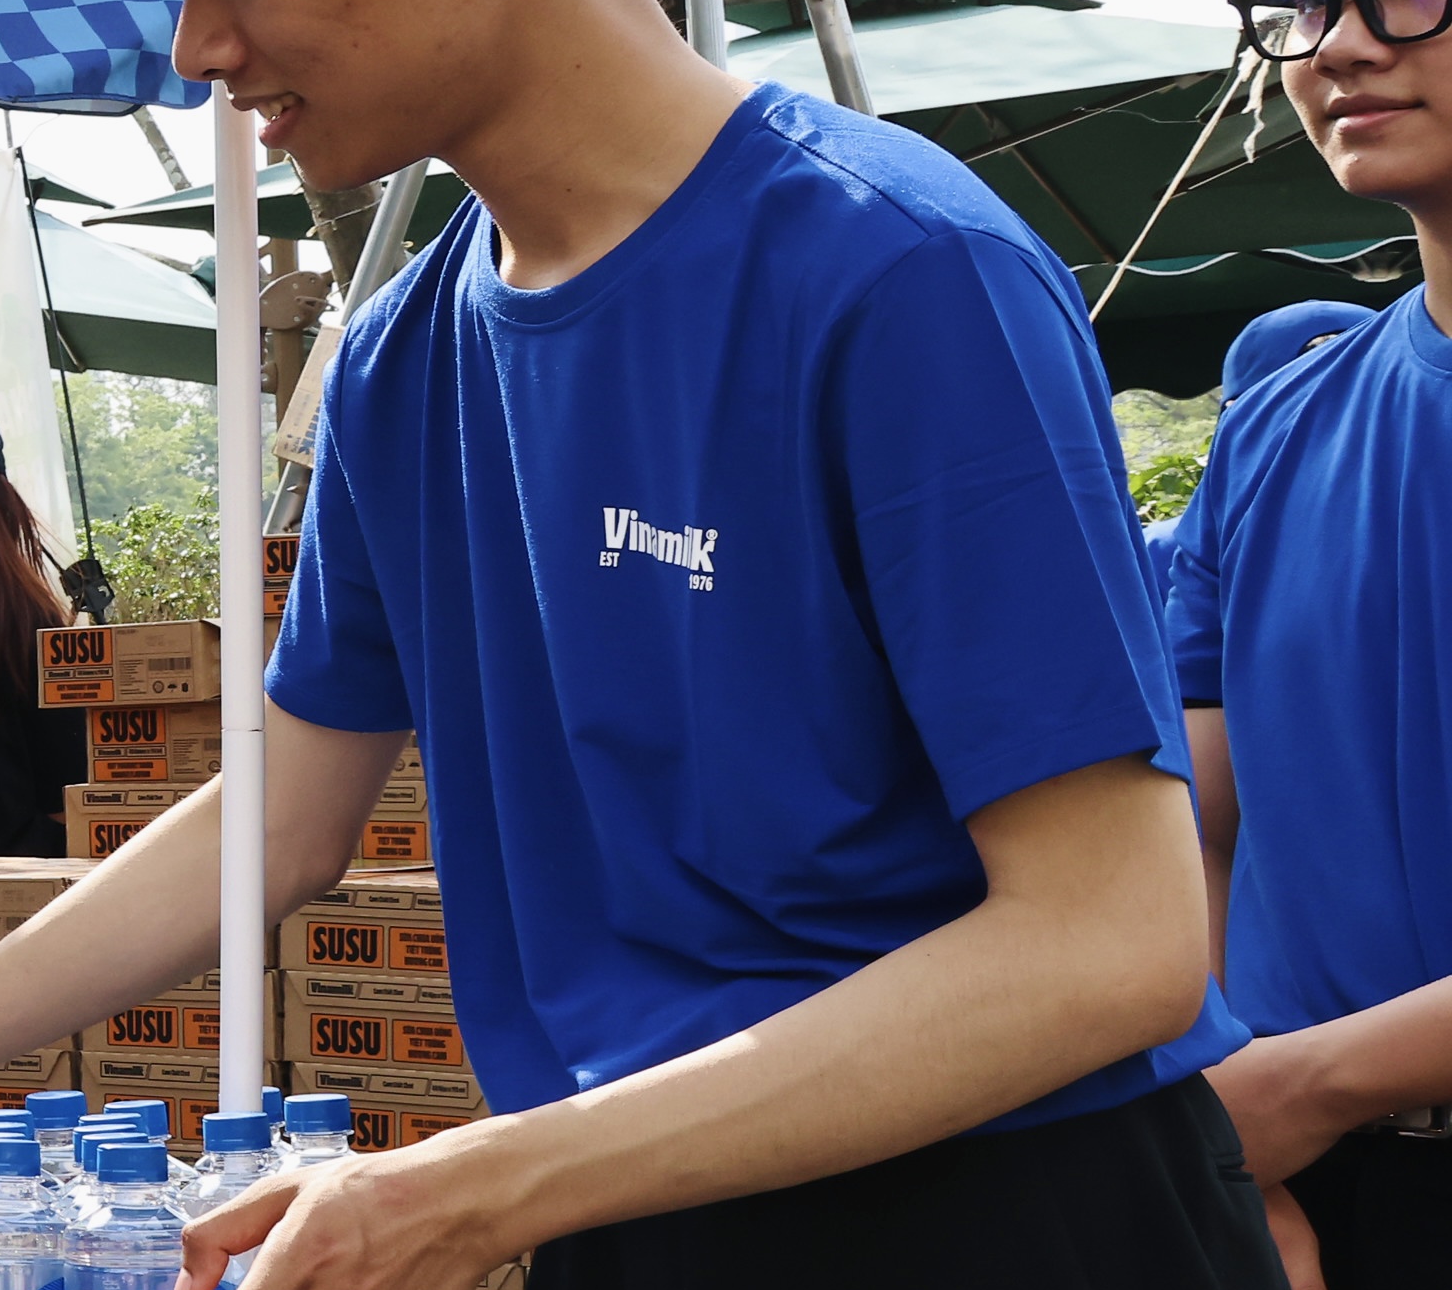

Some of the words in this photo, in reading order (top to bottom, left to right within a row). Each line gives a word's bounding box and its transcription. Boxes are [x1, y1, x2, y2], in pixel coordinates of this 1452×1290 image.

[599, 551, 620, 568] EST
[688, 574, 714, 592] 1976
[50, 630, 104, 665] SUSU
[100, 709, 158, 743] SUSU
[313, 926, 378, 963] SUSU
[113, 1009, 172, 1044] SUSU
[317, 1017, 381, 1056] SUSU
